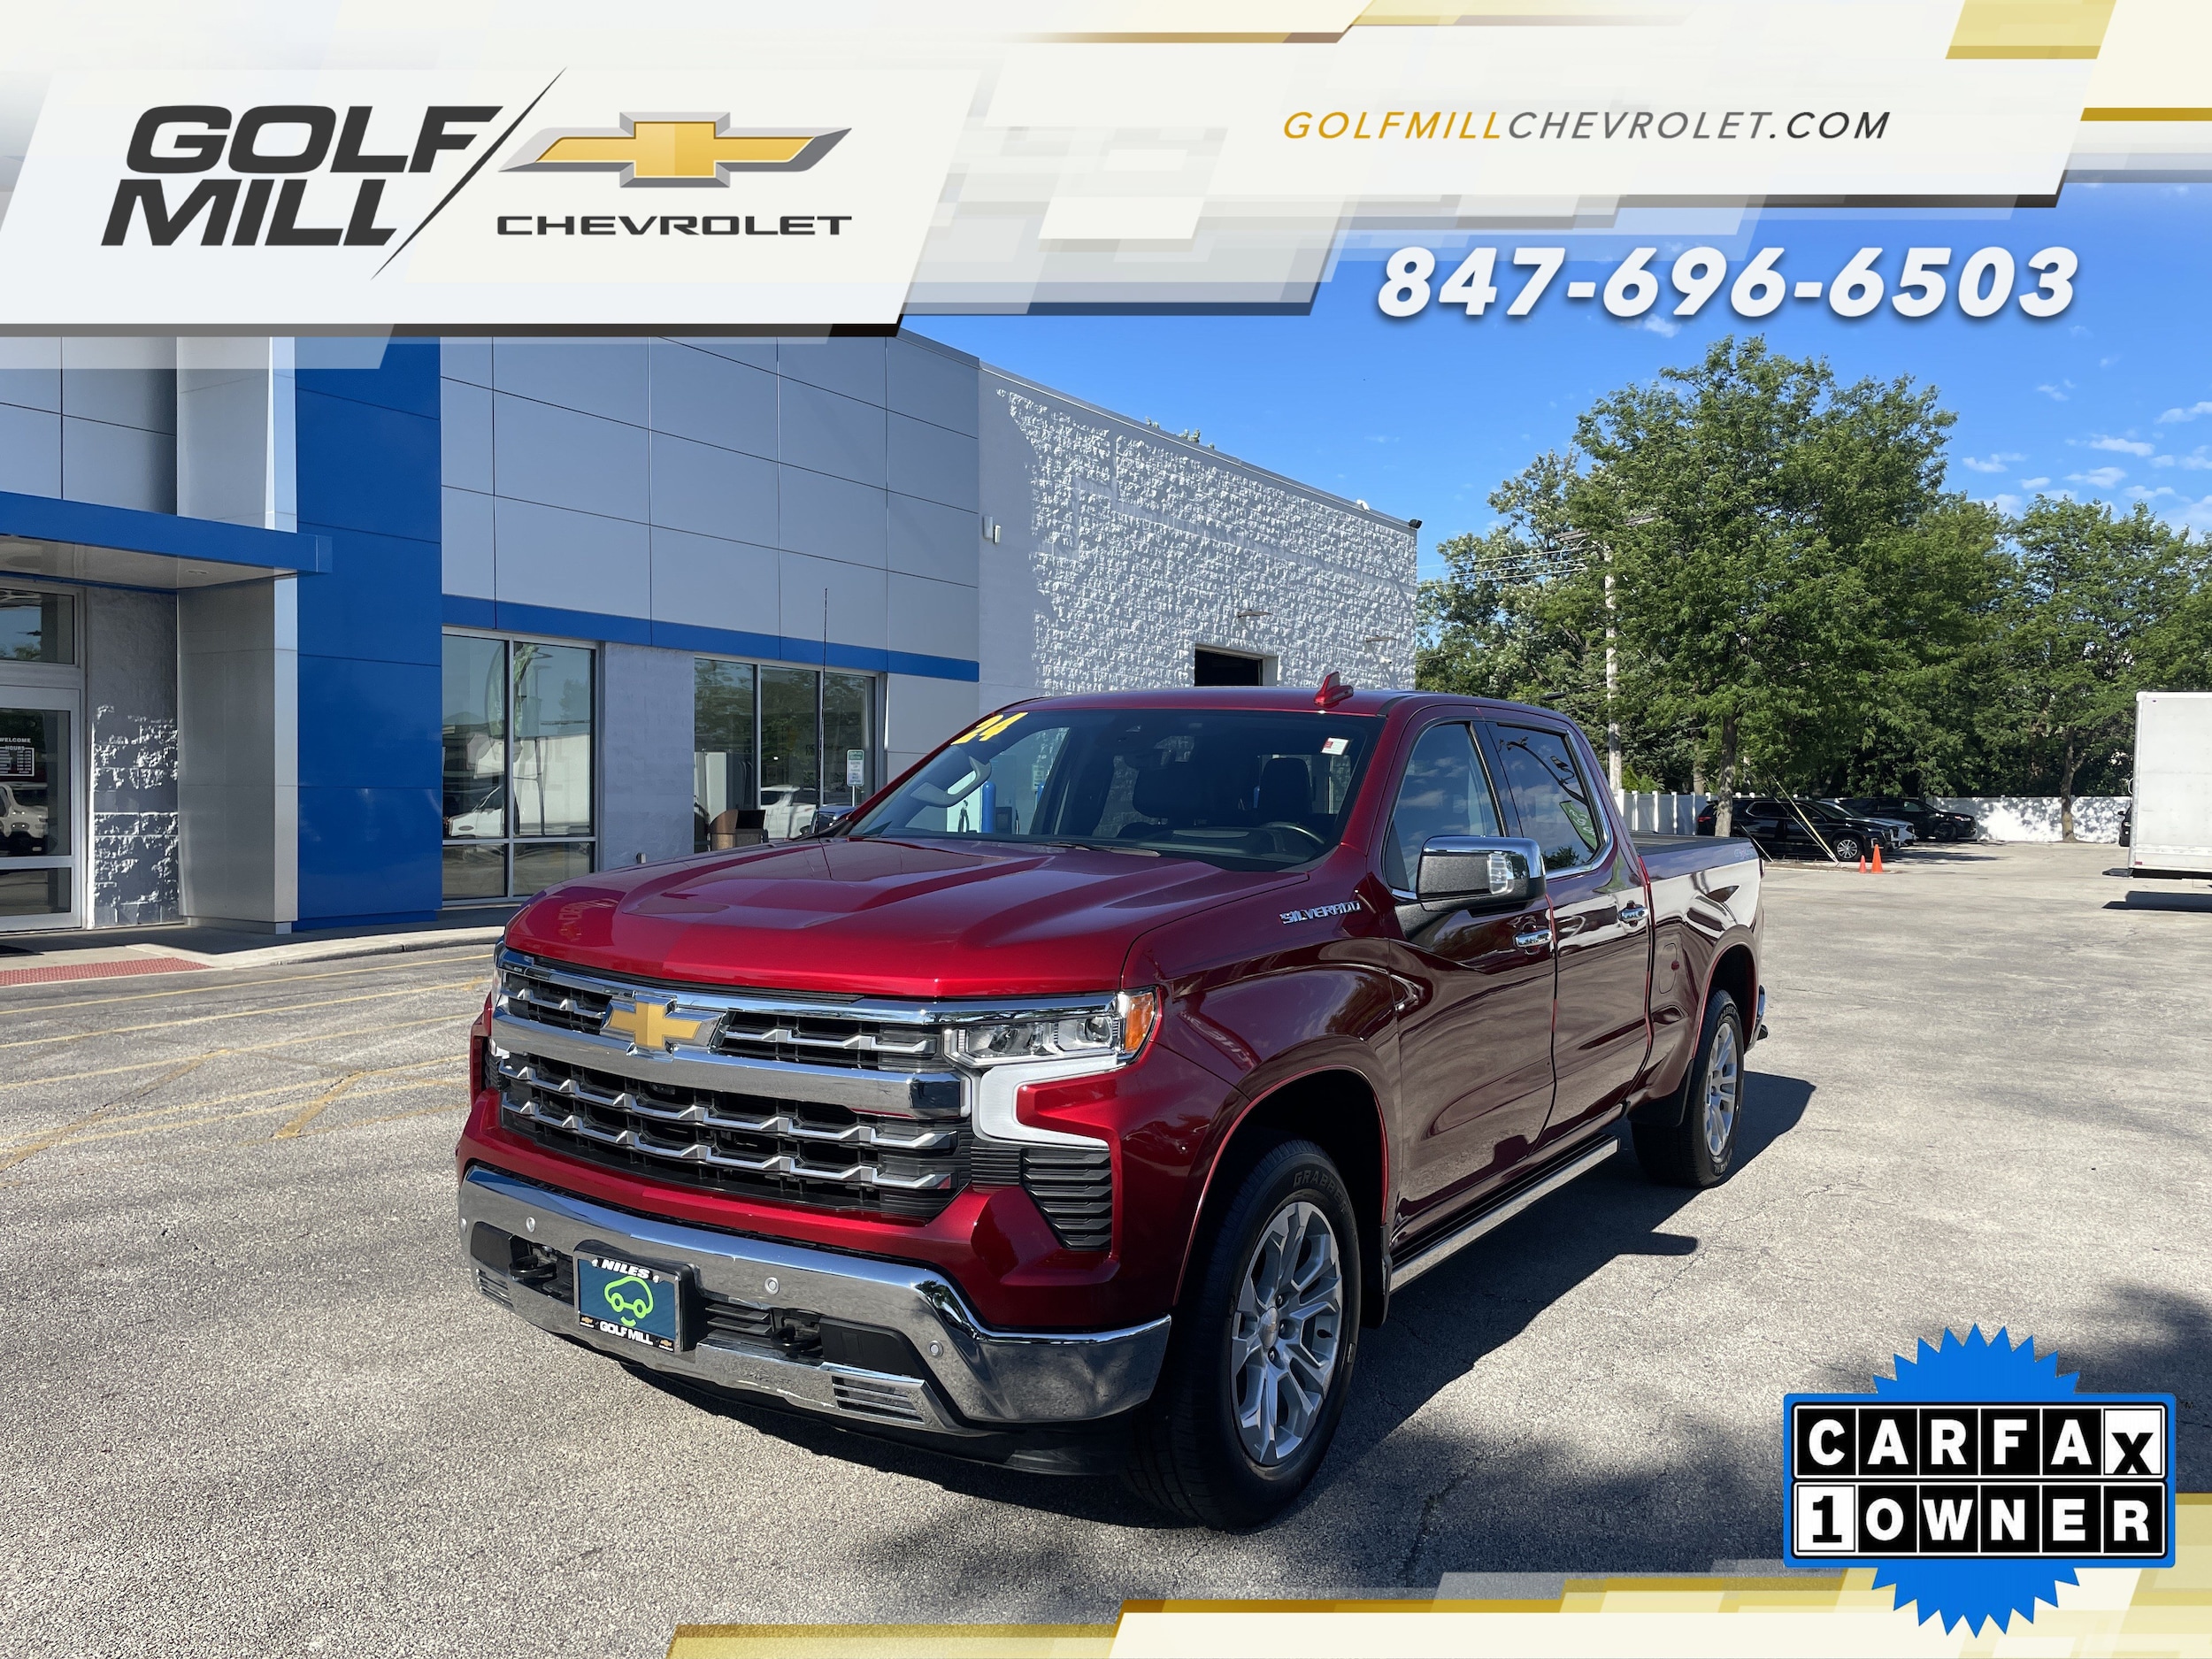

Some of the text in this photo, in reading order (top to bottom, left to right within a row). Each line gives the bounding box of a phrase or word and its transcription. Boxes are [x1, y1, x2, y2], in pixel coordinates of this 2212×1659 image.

[950, 712, 1028, 745] 24
[601, 1258, 650, 1279] NILES
[599, 1320, 654, 1346] GOLF MILL
